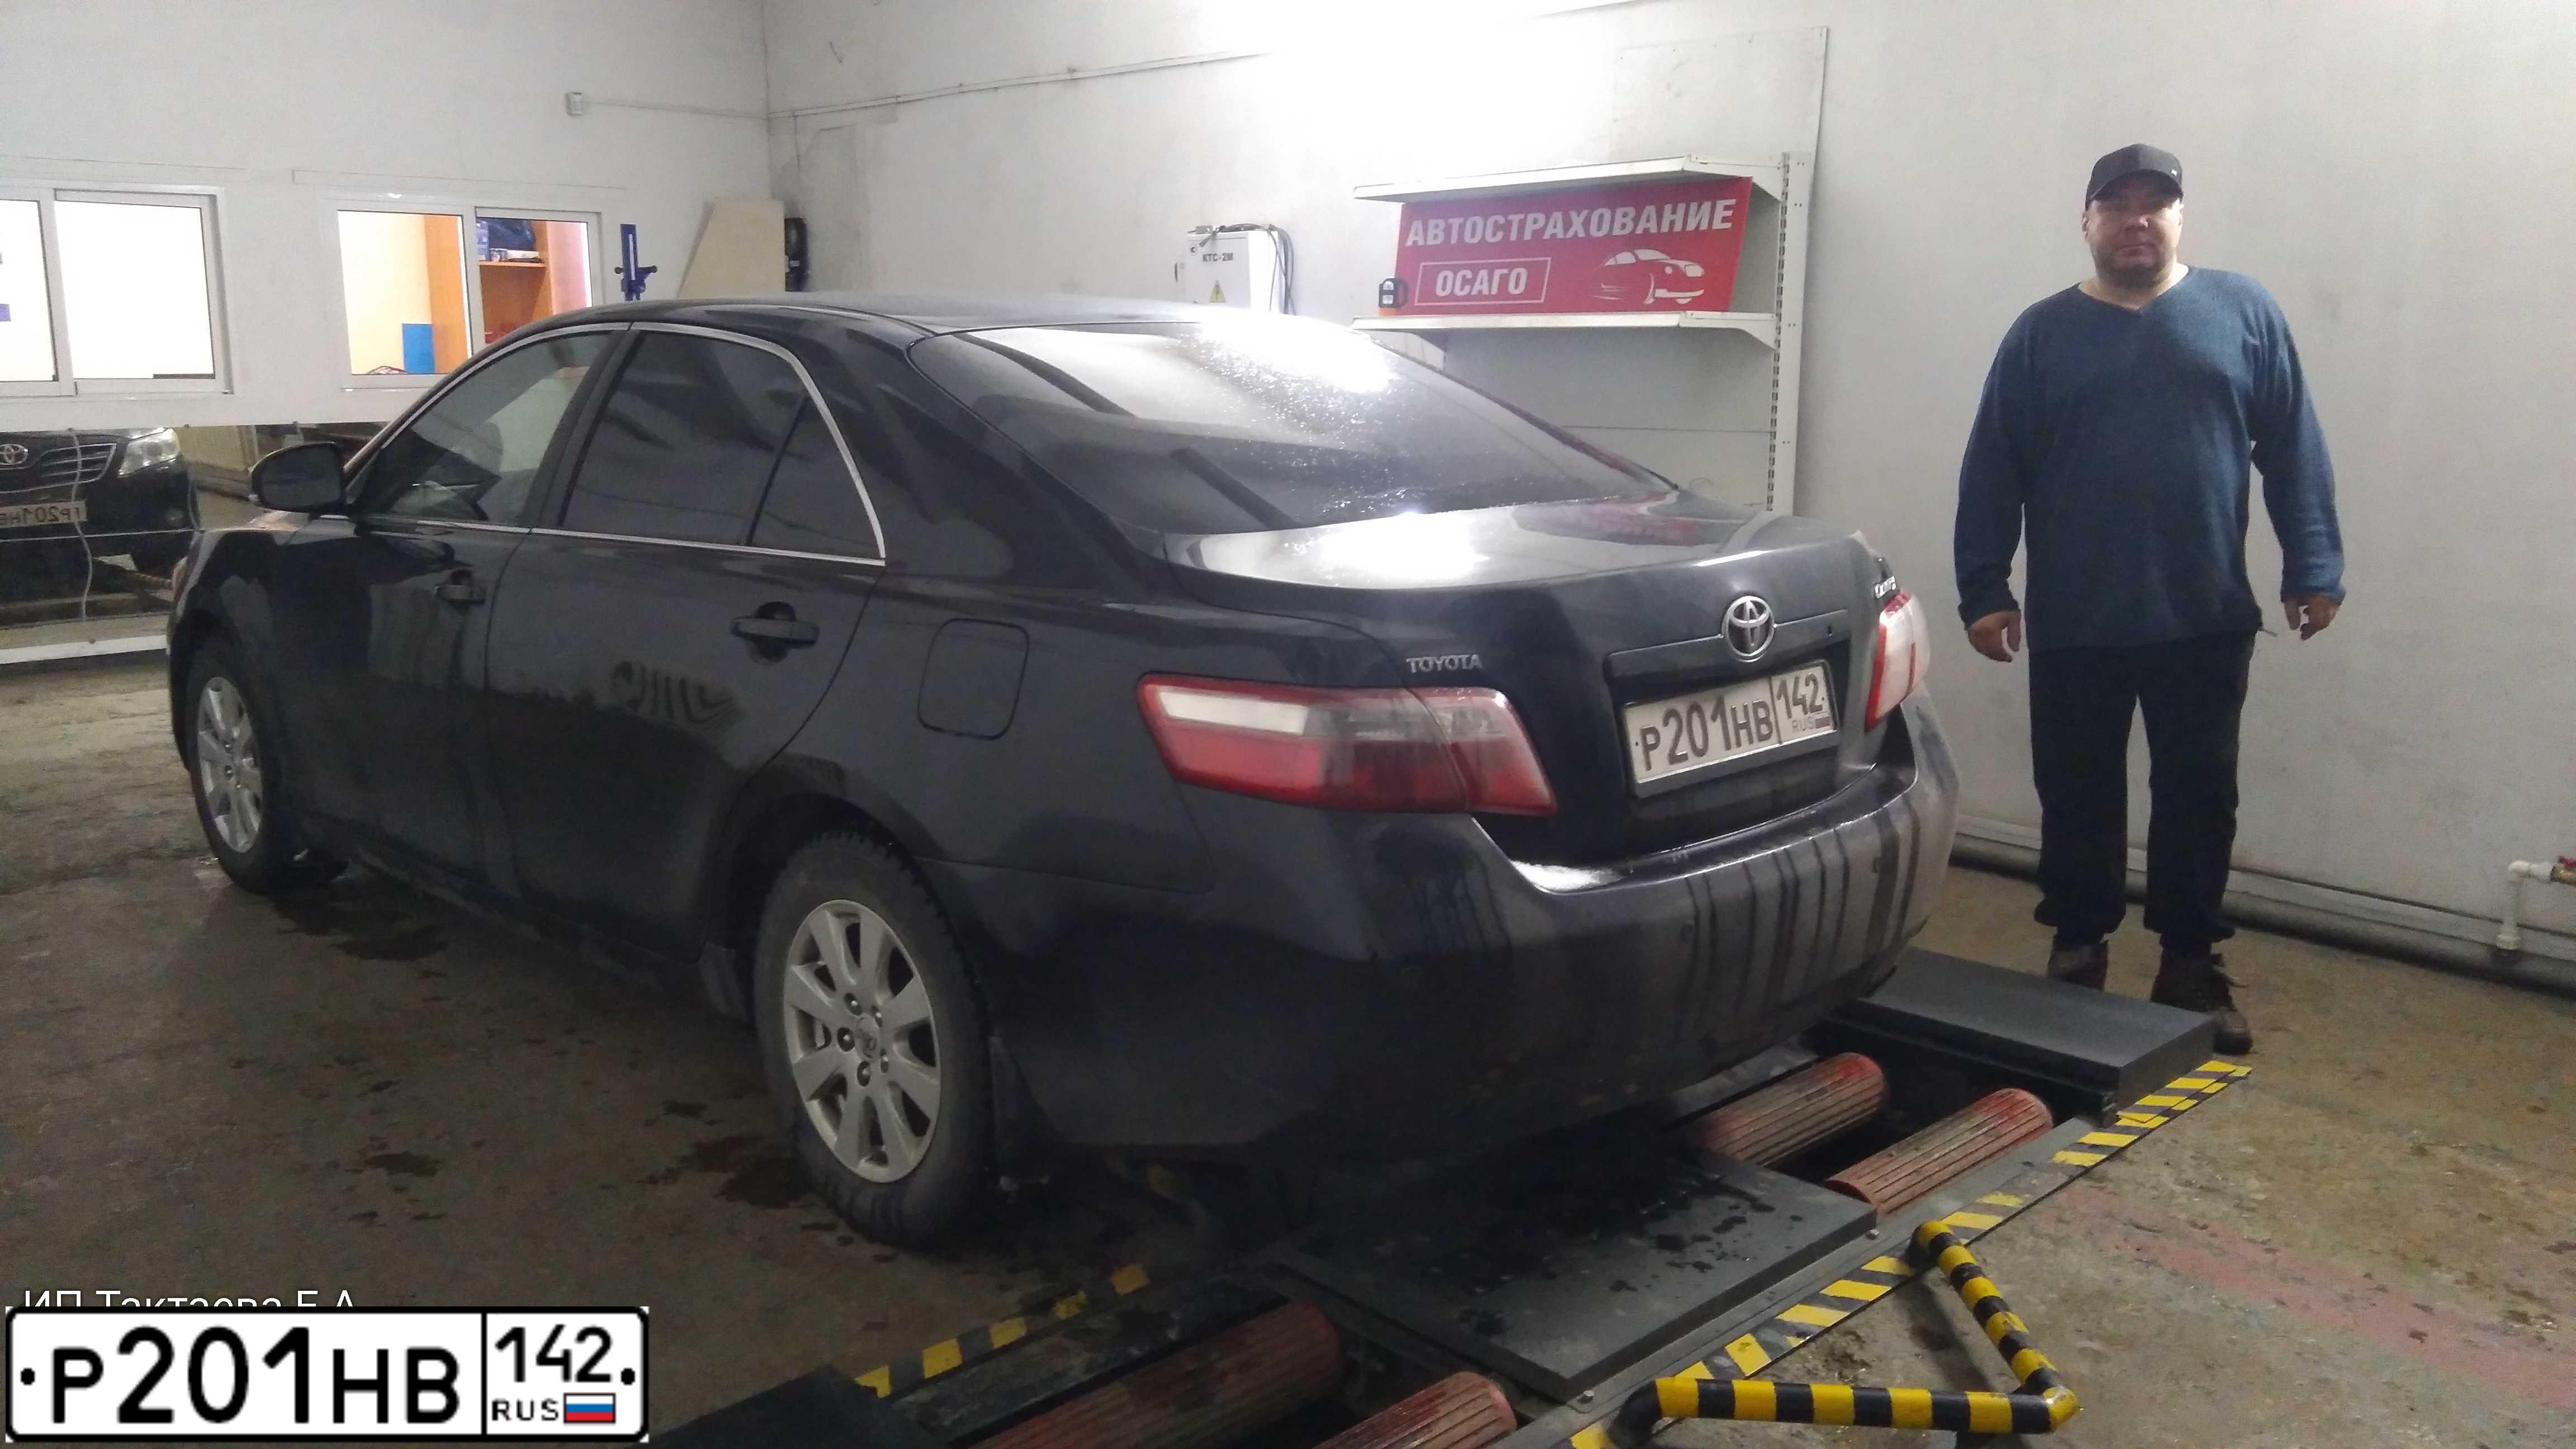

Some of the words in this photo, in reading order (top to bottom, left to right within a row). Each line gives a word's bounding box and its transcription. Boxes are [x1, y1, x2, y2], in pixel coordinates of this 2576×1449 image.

[1405, 199, 1736, 247] АВТОСТРАХОВАНИЕ
[1436, 268, 1527, 297] ОСАГО
[1406, 654, 1483, 673] TOYOTA
[1640, 695, 1774, 770] Р201НВ
[1777, 674, 1822, 719] 142
[1792, 716, 1815, 732] RUS
